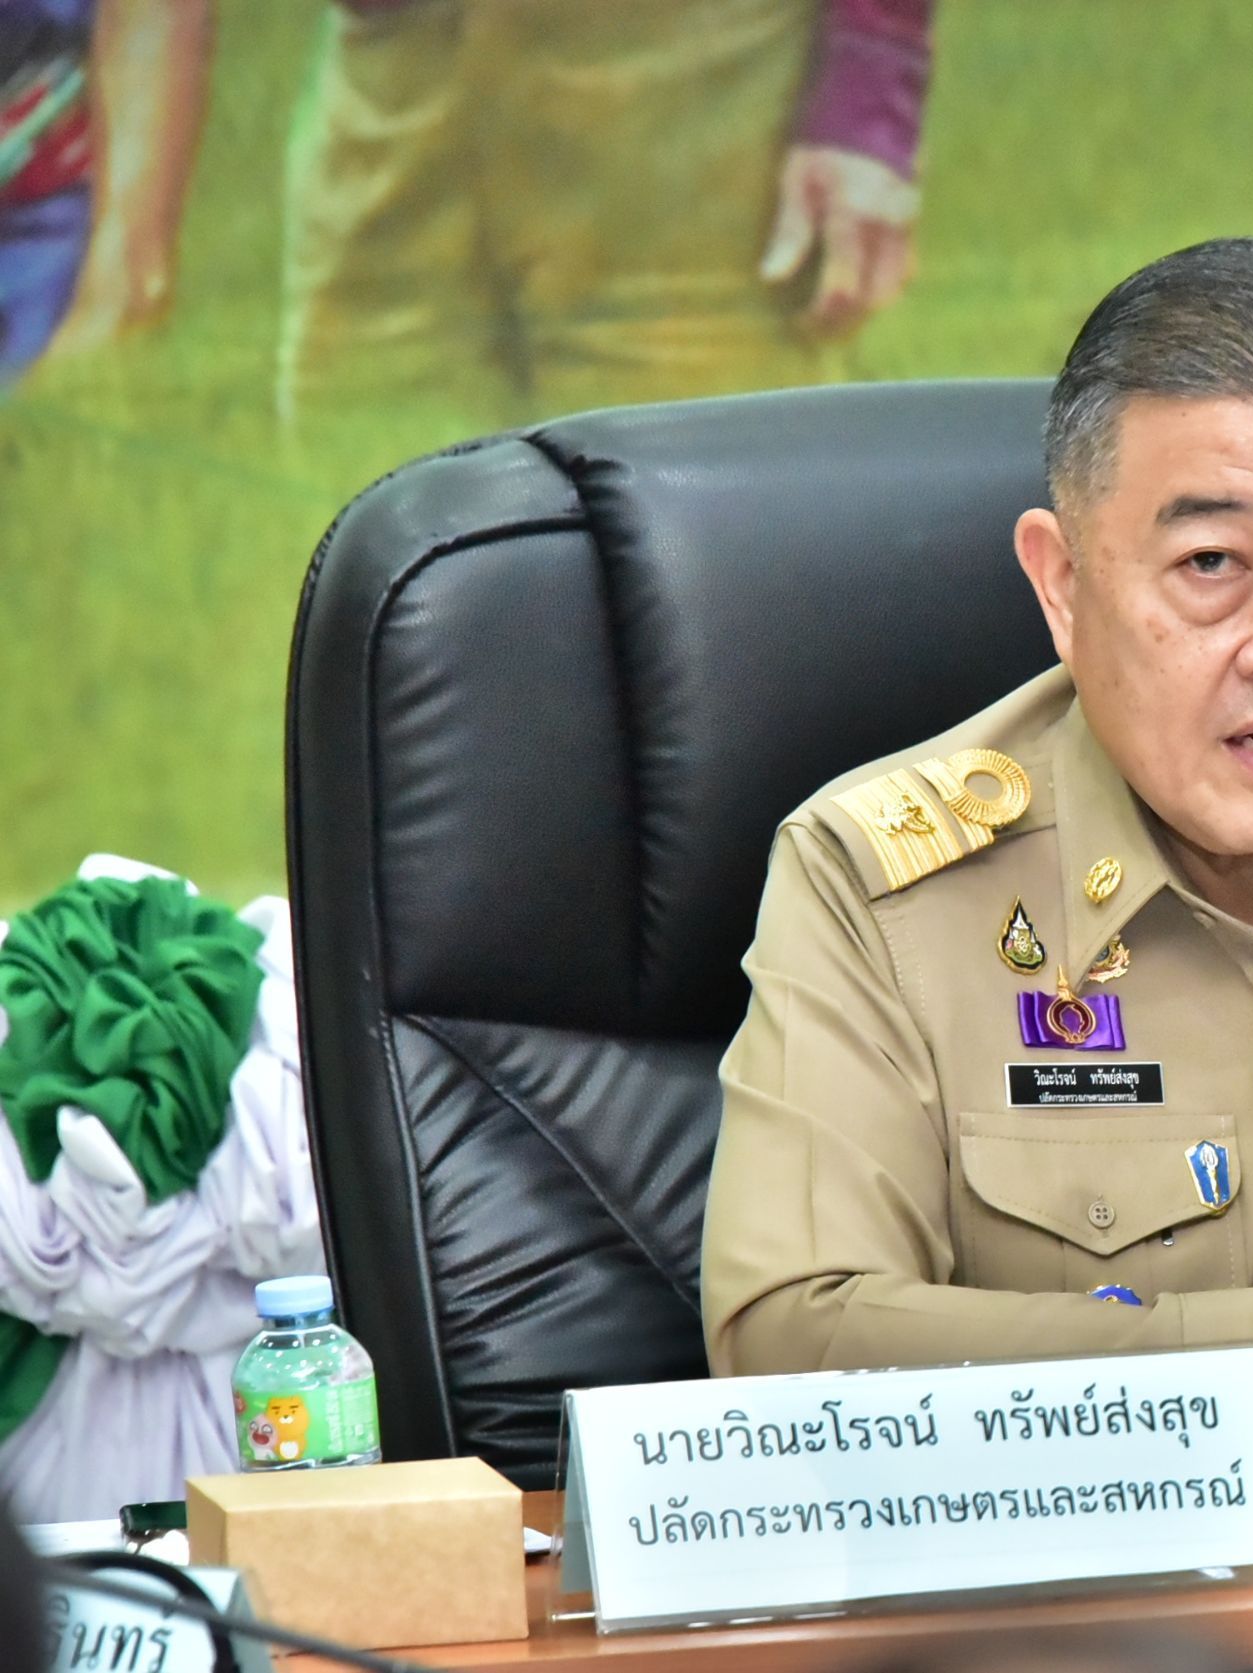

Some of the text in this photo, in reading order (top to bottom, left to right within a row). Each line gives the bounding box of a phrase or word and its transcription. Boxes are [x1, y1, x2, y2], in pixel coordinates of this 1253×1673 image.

[1034, 1068, 1140, 1089] วิณะโรจน์ ทรัพย์ส่งสุข
[633, 1383, 1219, 1465] นายวิณะโรจน์ ทรัพย์ส่งสุข
[629, 1459, 1246, 1546] ปลัดกระทรวงเกษตรและสหกรณ์
